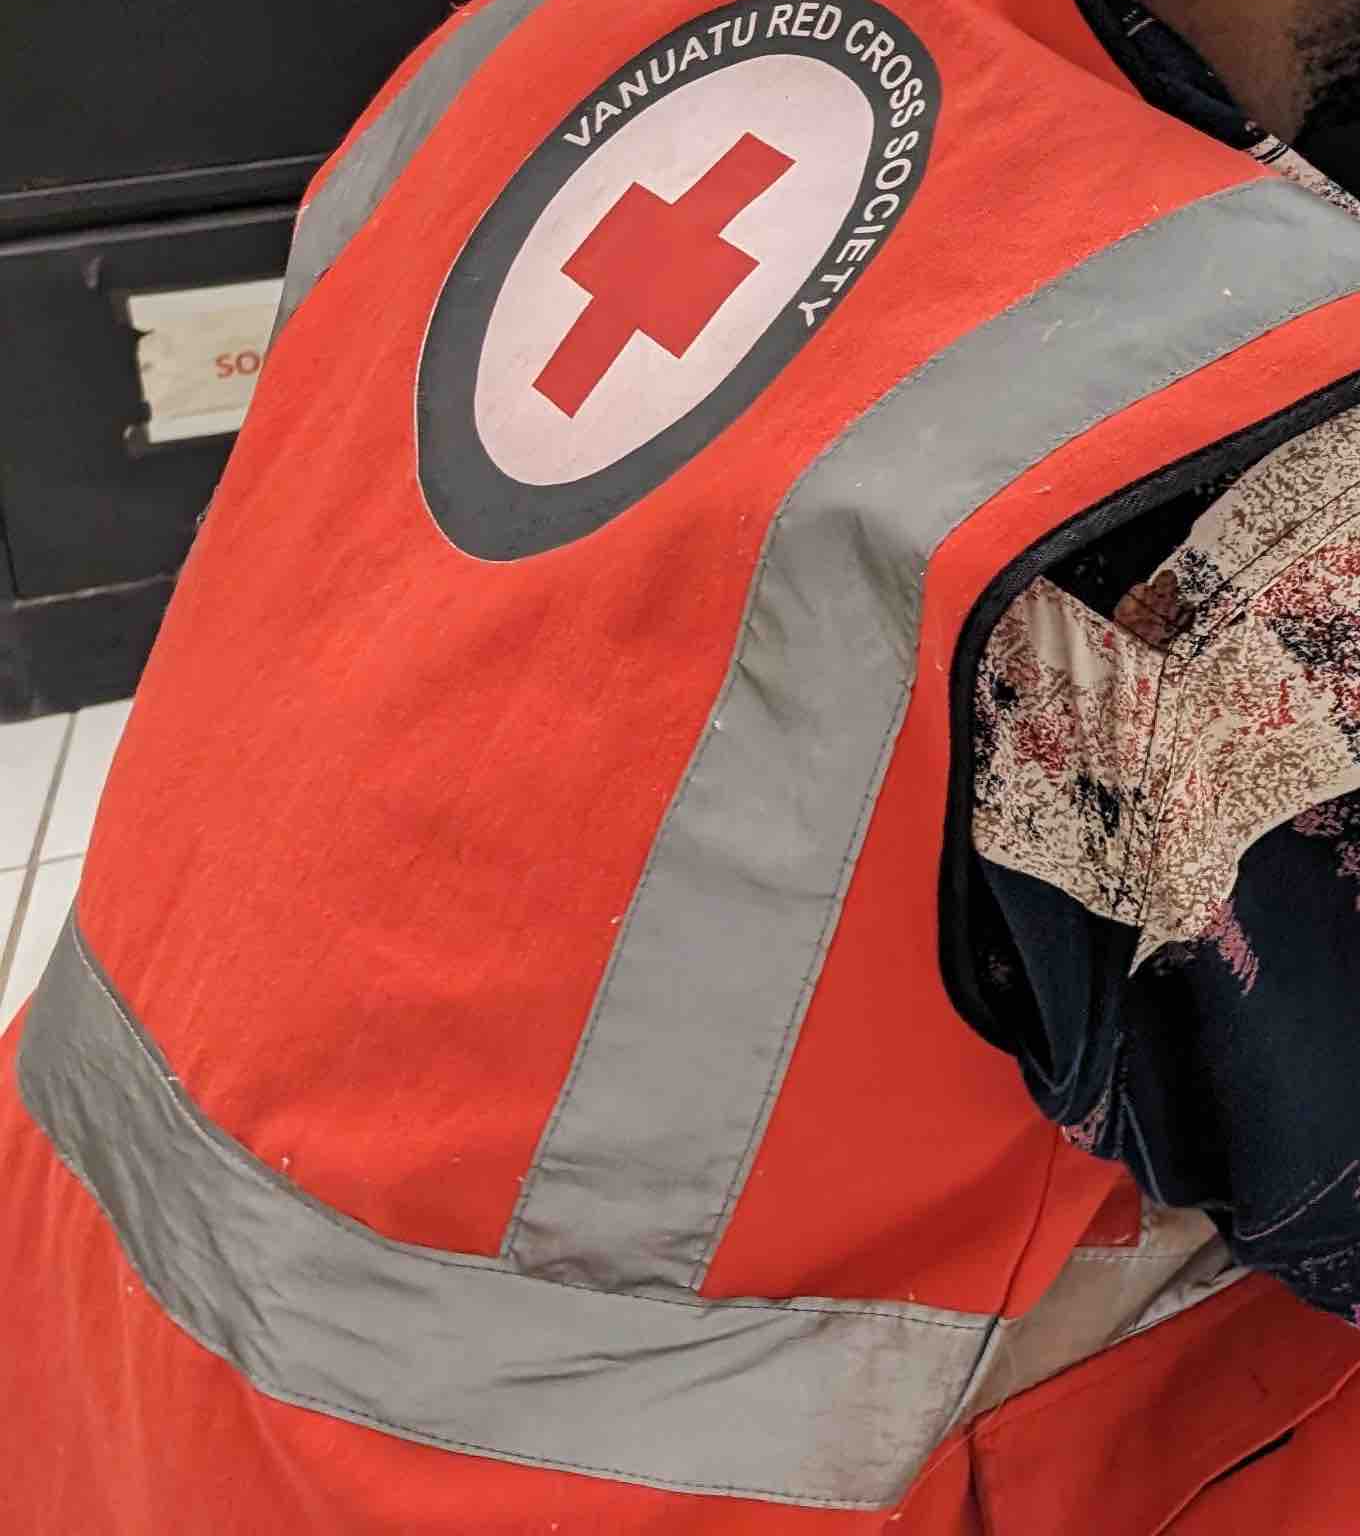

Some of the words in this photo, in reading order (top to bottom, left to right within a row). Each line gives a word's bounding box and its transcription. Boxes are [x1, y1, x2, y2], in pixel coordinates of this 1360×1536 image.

[766, 1, 842, 40] RED
[844, 17, 926, 129] CROSS
[564, 11, 757, 149] VANUATU
[798, 130, 919, 327] SOCIETY
[215, 348, 261, 380] SO
